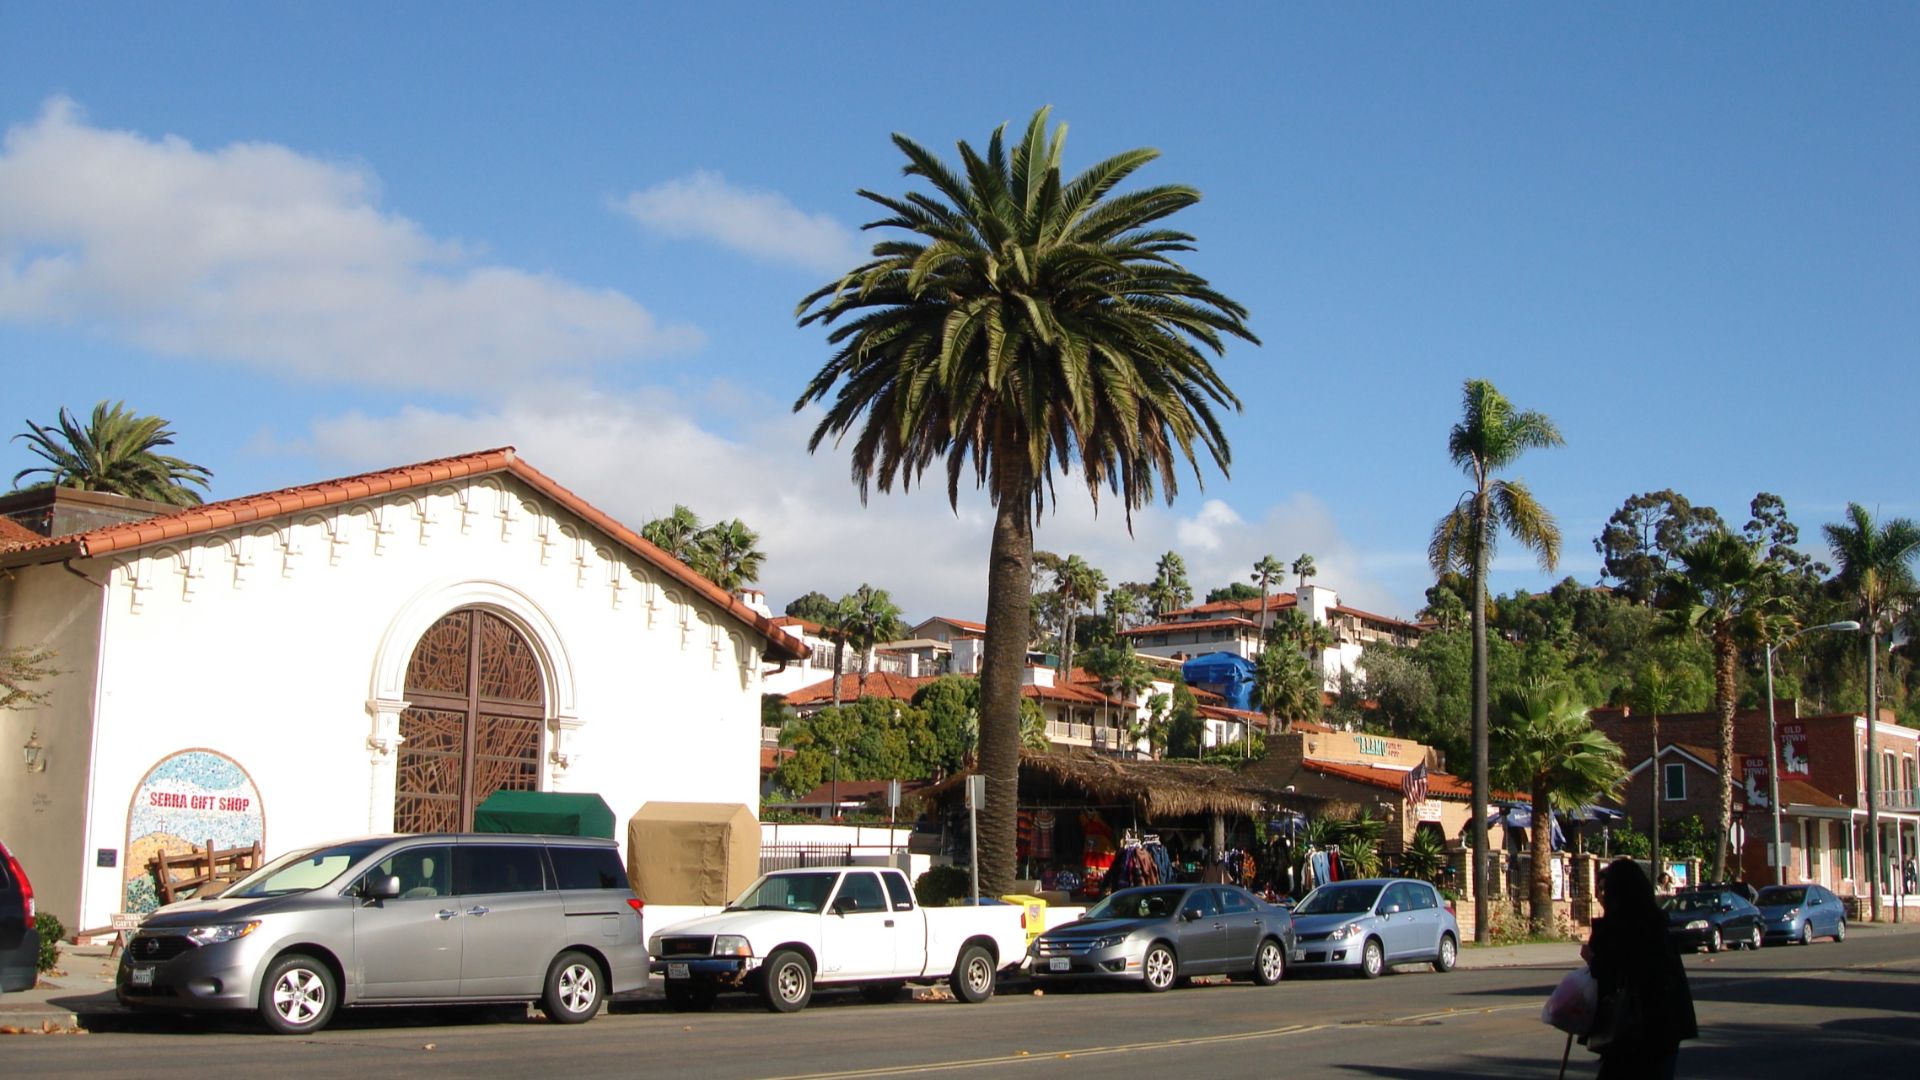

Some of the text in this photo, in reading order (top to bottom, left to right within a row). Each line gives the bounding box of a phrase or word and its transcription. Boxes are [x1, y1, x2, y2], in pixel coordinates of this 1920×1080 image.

[1784, 726, 1801, 734] OLD
[1781, 734, 1806, 742] TOWN
[1360, 737, 1385, 756] ALAMO
[1746, 759, 1763, 767] OLD
[1743, 767, 1767, 775] TOWN
[150, 792, 250, 812] SERRA GIFT SHOP
